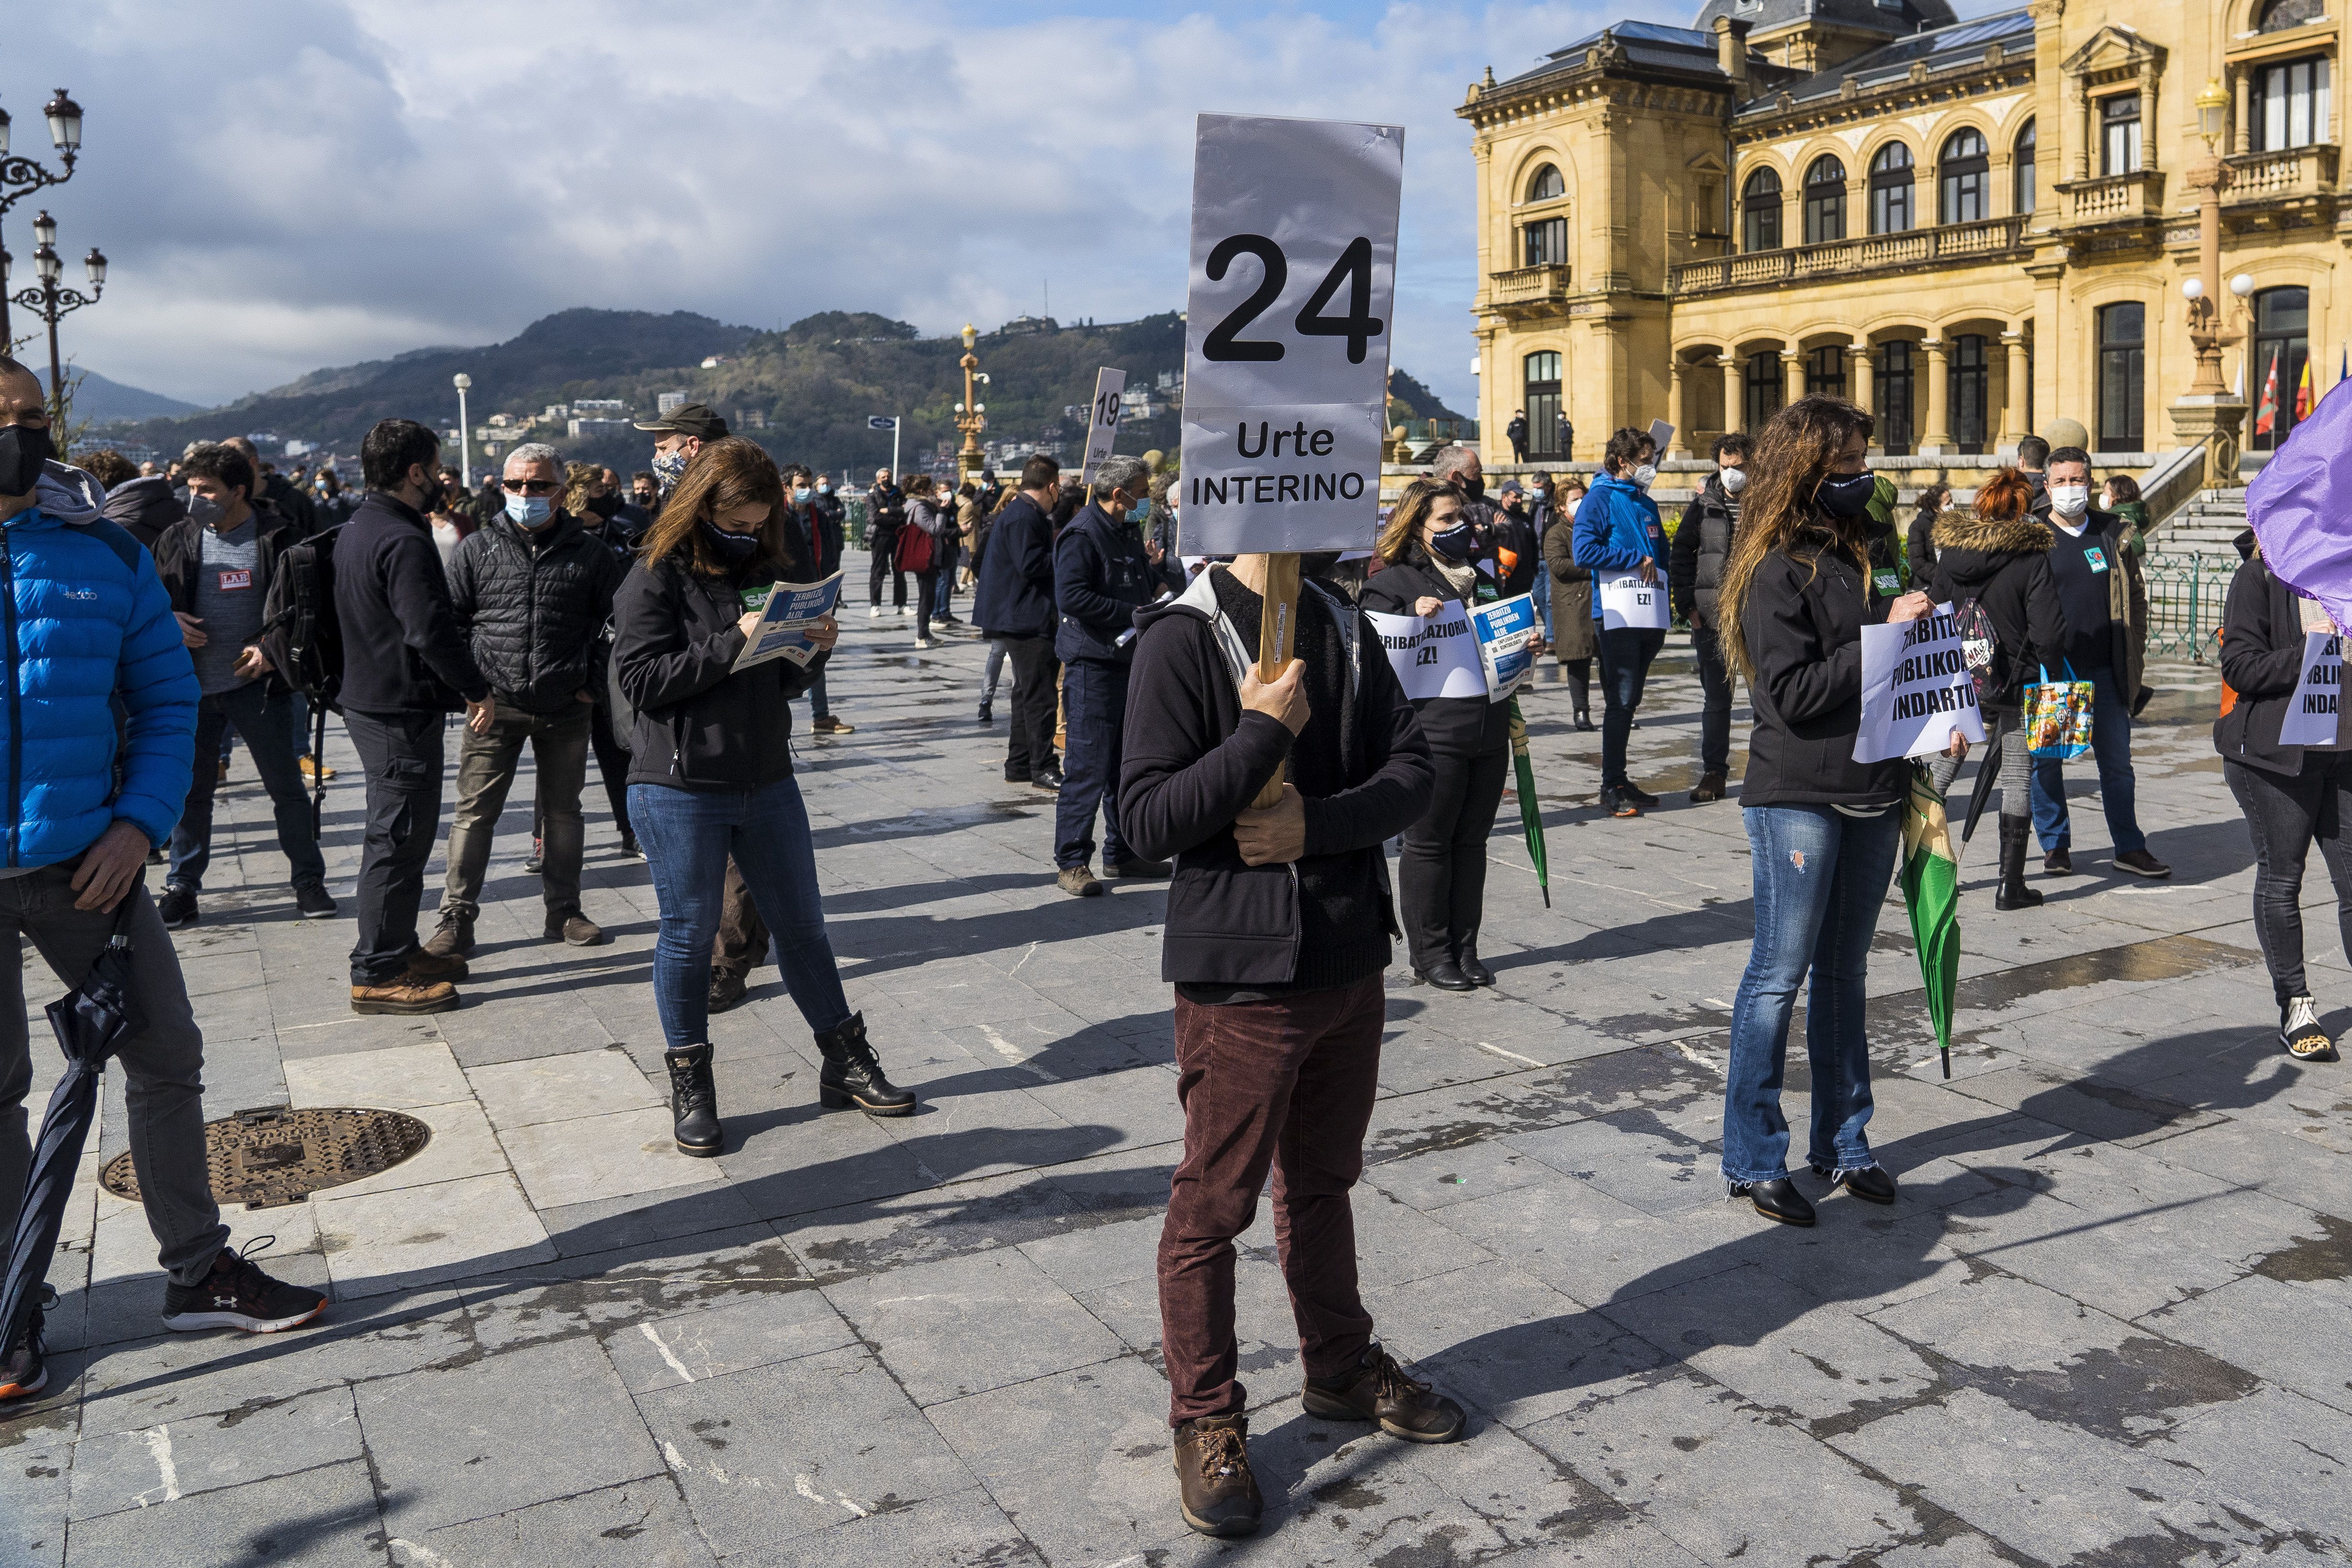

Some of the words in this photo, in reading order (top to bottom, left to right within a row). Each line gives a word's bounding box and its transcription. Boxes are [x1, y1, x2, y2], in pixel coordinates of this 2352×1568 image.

[1202, 233, 1384, 365] 24
[1097, 391, 1120, 427] 19
[1237, 421, 1335, 459] Urte
[1093, 447, 1107, 459] Urte
[1193, 472, 1365, 507] INTERINO
[223, 573, 248, 584] LAB
[789, 595, 825, 610] PUBLIKOEN
[793, 588, 824, 602] ZERBITZU
[1637, 593, 1651, 606] EZ!
[785, 610, 805, 620] ALDE
[1486, 605, 1511, 620] ZERBITZU
[1490, 612, 1520, 630] PUBLIKOEN
[1494, 626, 1509, 639] ALDE
[1416, 645, 1438, 667] EZ!
[2303, 665, 2341, 685] UBLI
[1892, 682, 1976, 722] INDARTU
[2303, 693, 2339, 714] INDA
